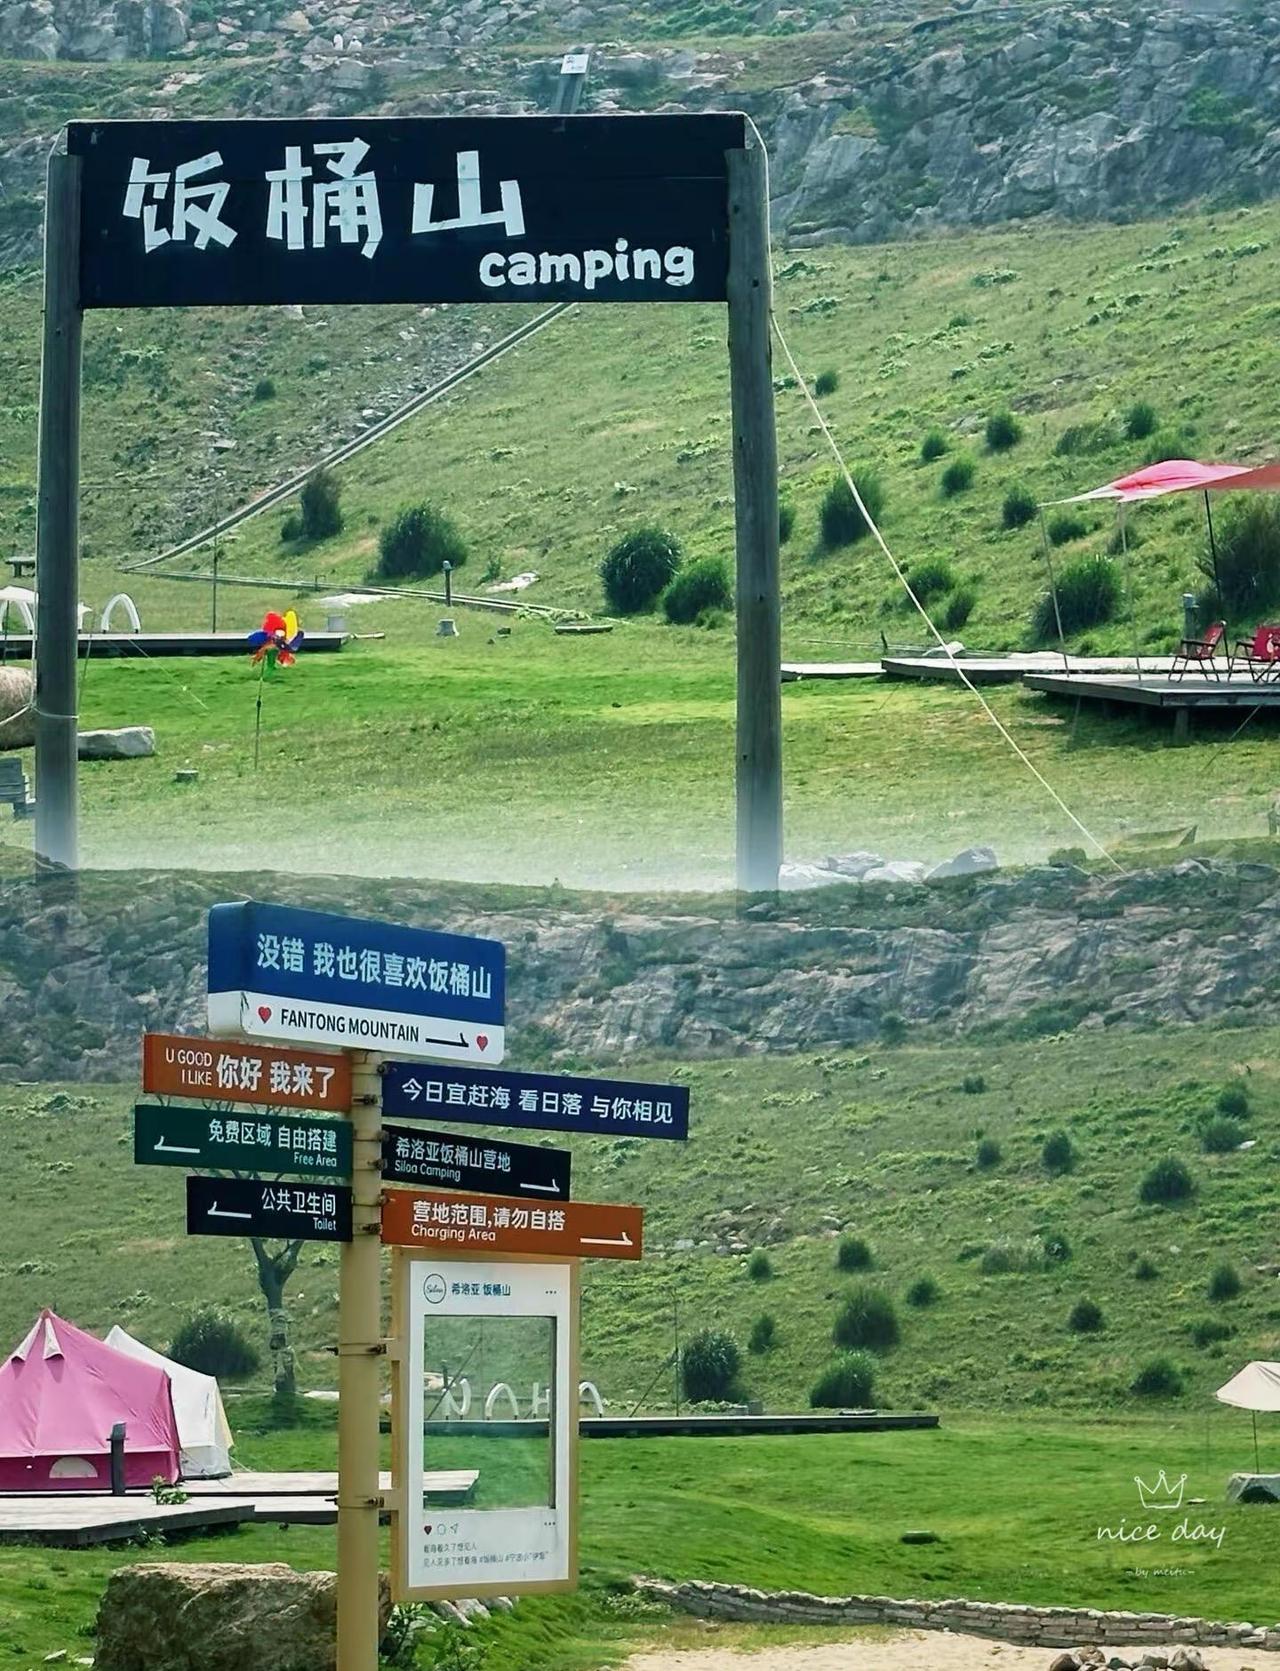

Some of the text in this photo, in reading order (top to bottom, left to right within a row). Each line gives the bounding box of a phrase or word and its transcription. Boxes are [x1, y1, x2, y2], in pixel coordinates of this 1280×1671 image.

[122, 137, 526, 259] 饭桶山
[479, 237, 696, 290] camping
[256, 933, 492, 1000] 没错 我也很喜欢饭桶山
[280, 1008, 420, 1043] FANTONG MOUNTAIN
[165, 1047, 213, 1067] U GOOD
[181, 1069, 212, 1086] I LIKE
[215, 1053, 336, 1099] 你好 我来了
[401, 1077, 674, 1125] 今日宜赶海 看日落 与你相见
[208, 1117, 337, 1153] 免费区域 自由搭建
[293, 1151, 337, 1167] Free Area
[394, 1159, 462, 1182] Siloa Camping
[395, 1137, 512, 1173] 希洛亚饭桶山营地
[261, 1186, 337, 1217] 公共卫生间
[313, 1217, 337, 1231] Toilet
[411, 1223, 496, 1242] Charging Area
